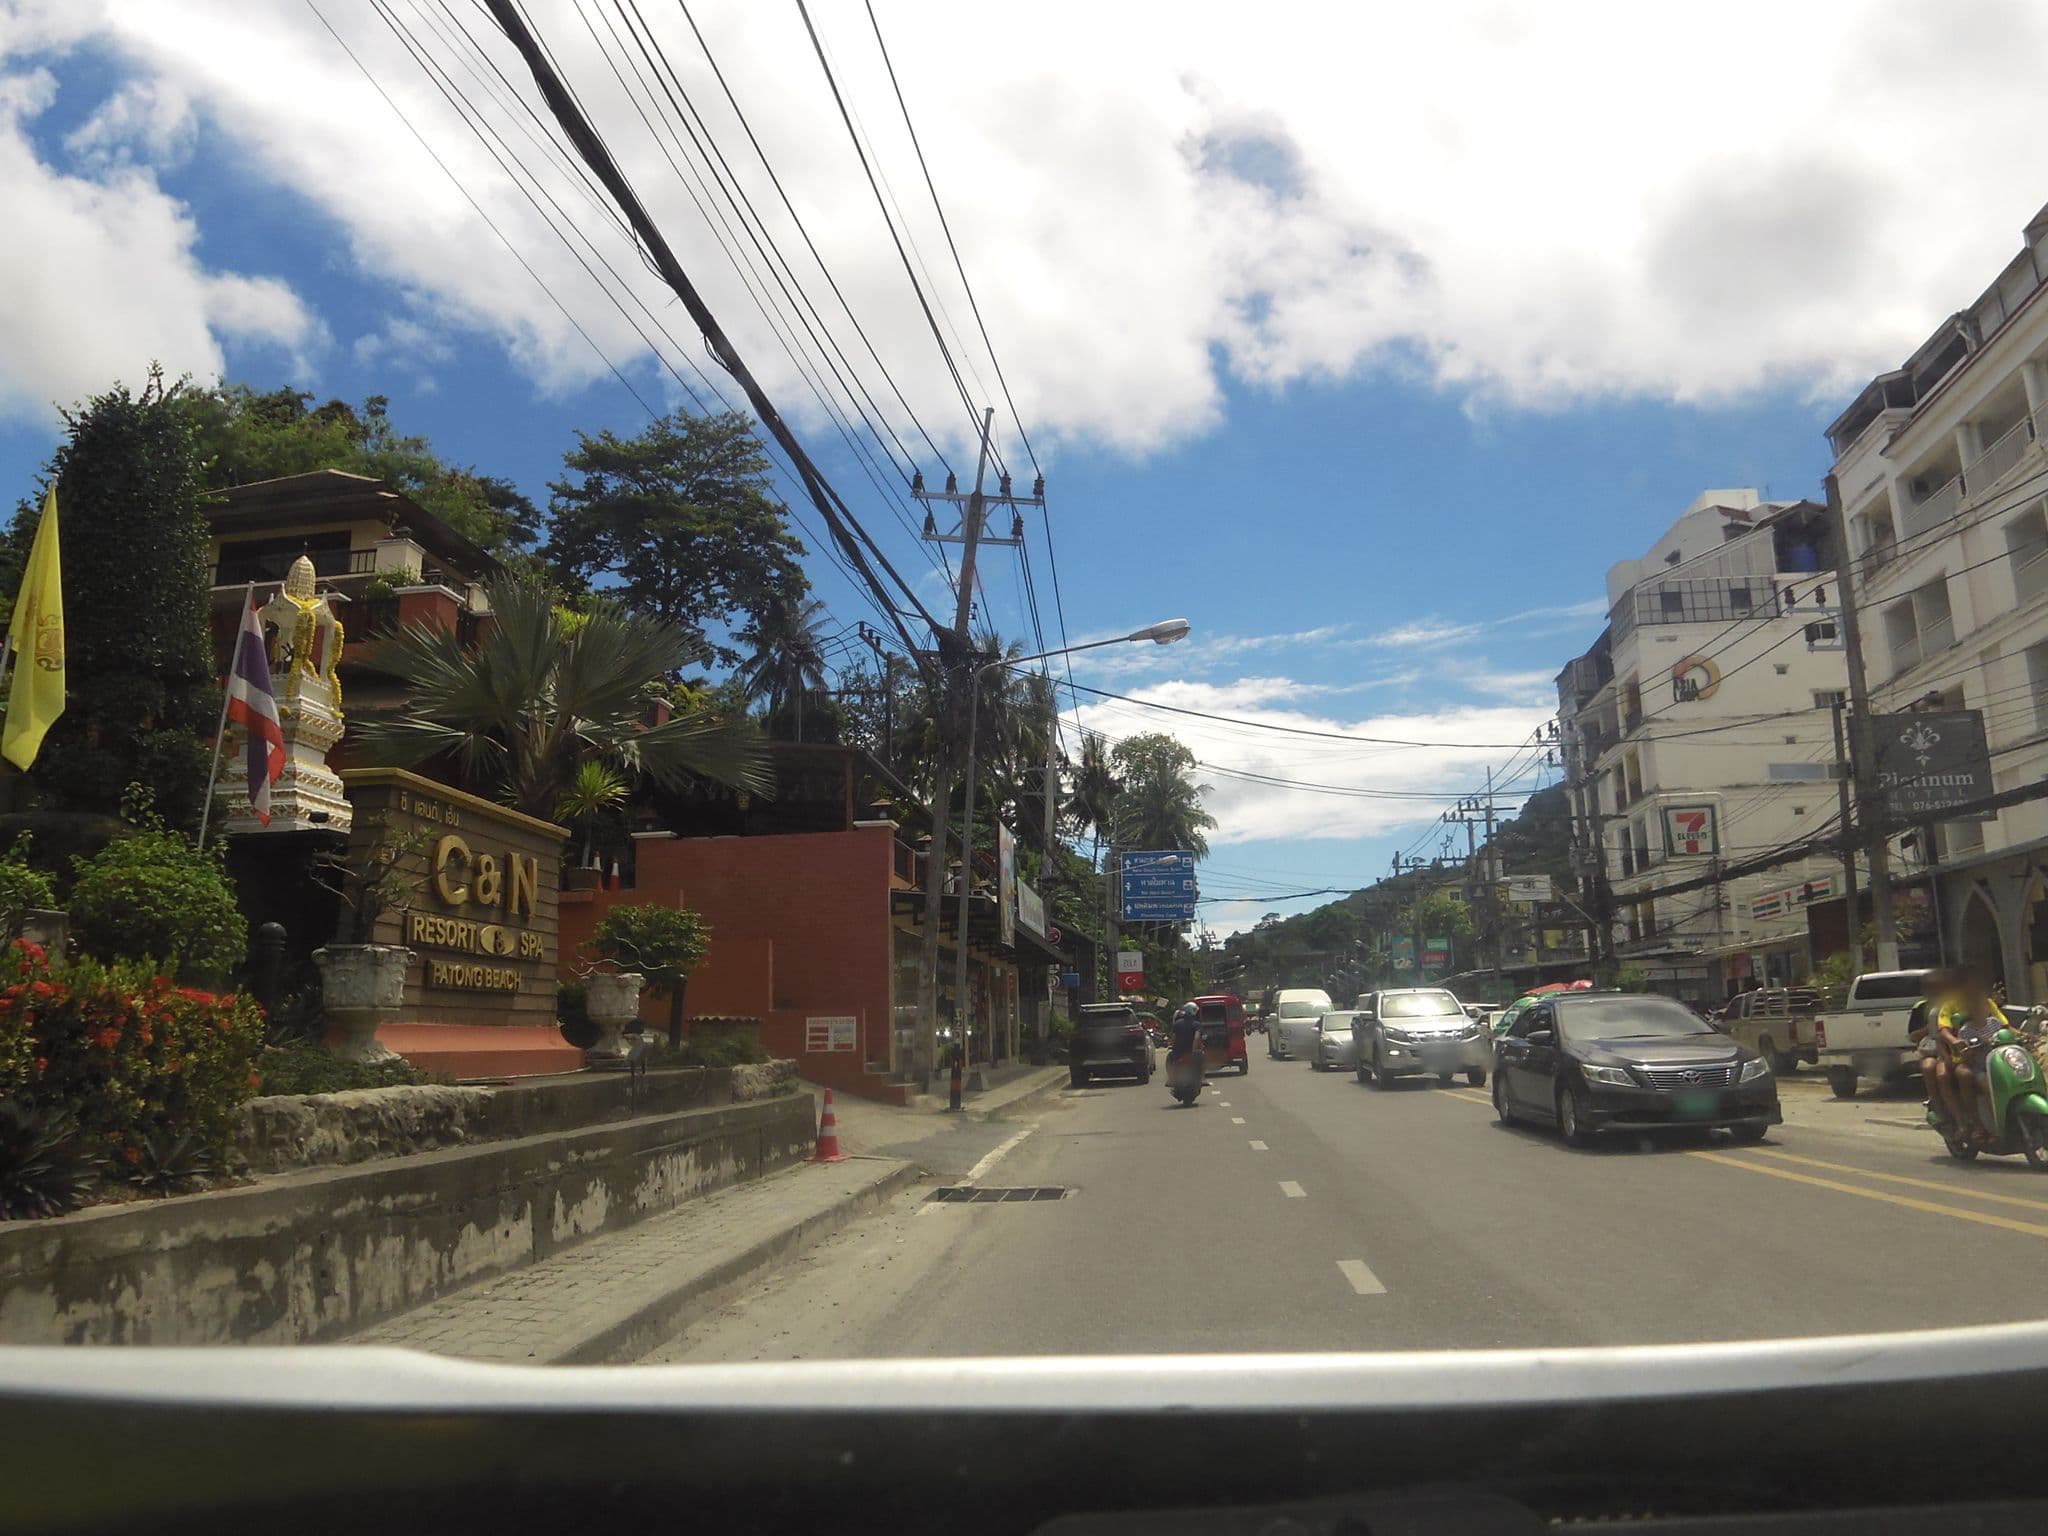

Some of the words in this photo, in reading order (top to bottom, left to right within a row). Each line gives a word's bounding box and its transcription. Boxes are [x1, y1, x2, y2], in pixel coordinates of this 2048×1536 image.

[413, 915, 478, 949] RESORT
[520, 930, 545, 959] SPA
[432, 962, 483, 988] PATONG
[485, 967, 522, 991] BEACH
